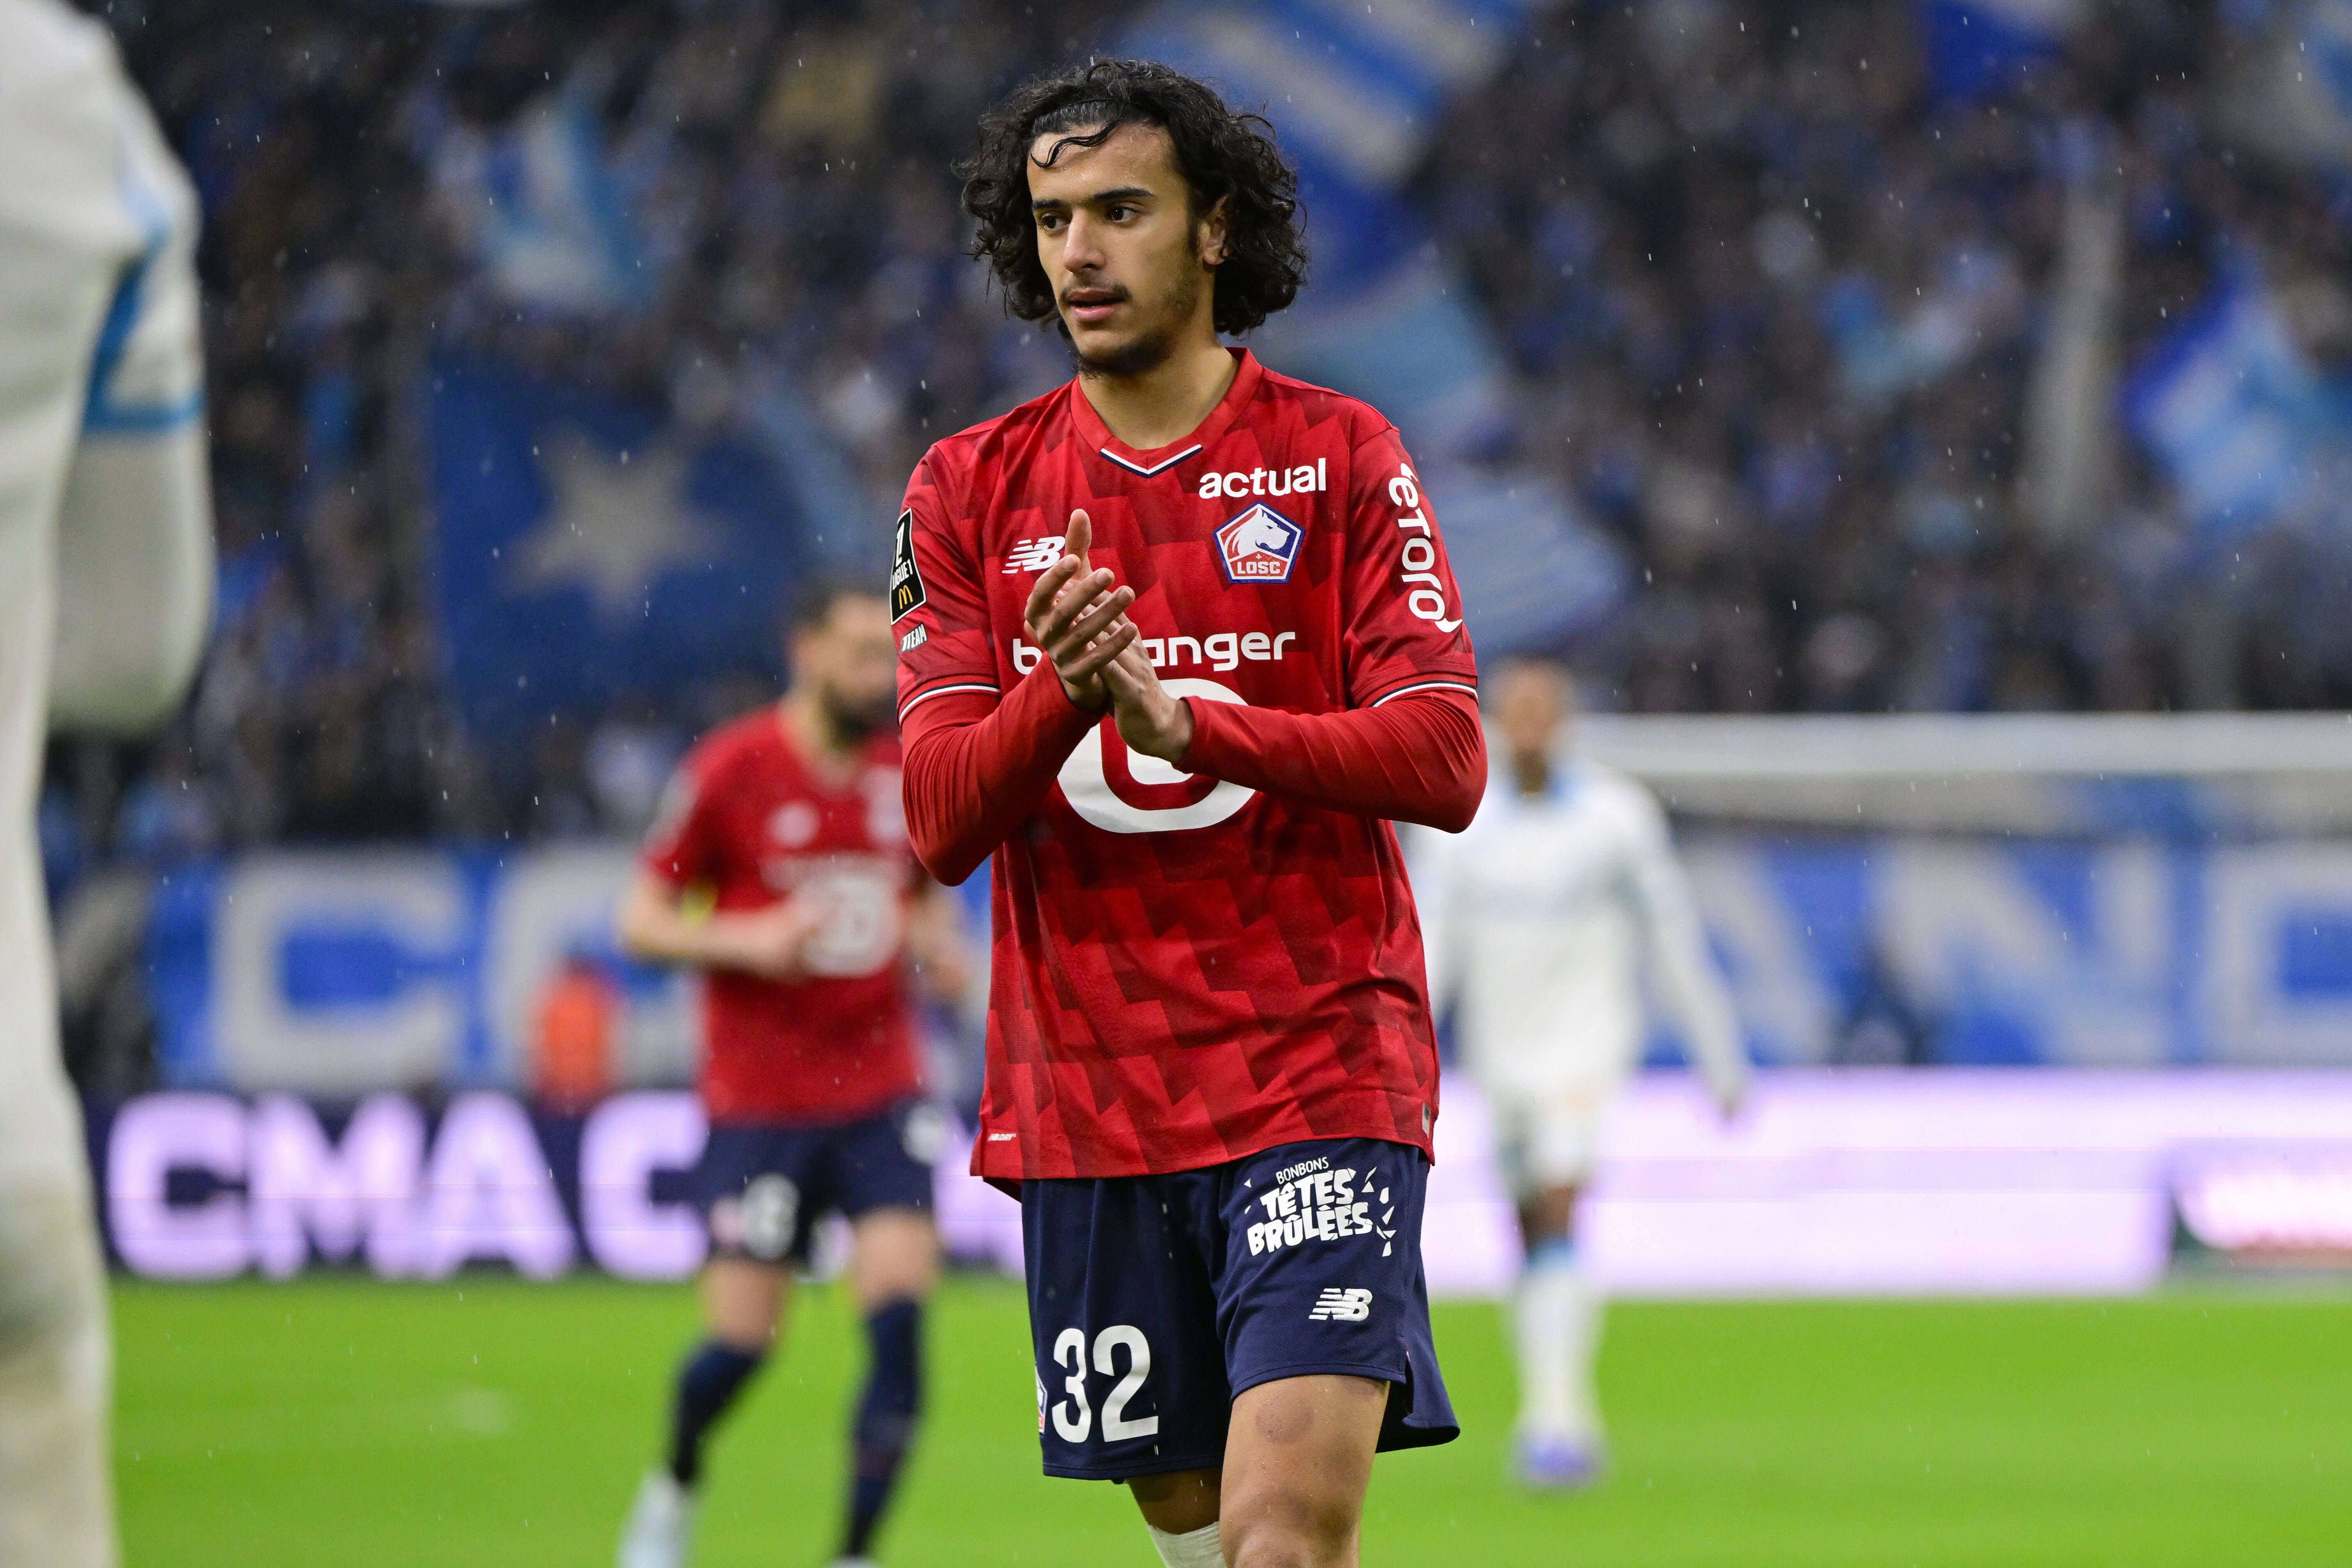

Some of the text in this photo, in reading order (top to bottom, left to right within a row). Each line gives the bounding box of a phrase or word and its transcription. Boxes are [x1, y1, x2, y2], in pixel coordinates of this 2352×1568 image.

[1199, 458, 1326, 499] actual
[1237, 561, 1280, 574] LOSC
[1013, 631, 1296, 675] banger
[1276, 1156, 1329, 1185] BONBONS
[1260, 1168, 1356, 1221] TÊTES
[1052, 1325, 1159, 1443] 32
